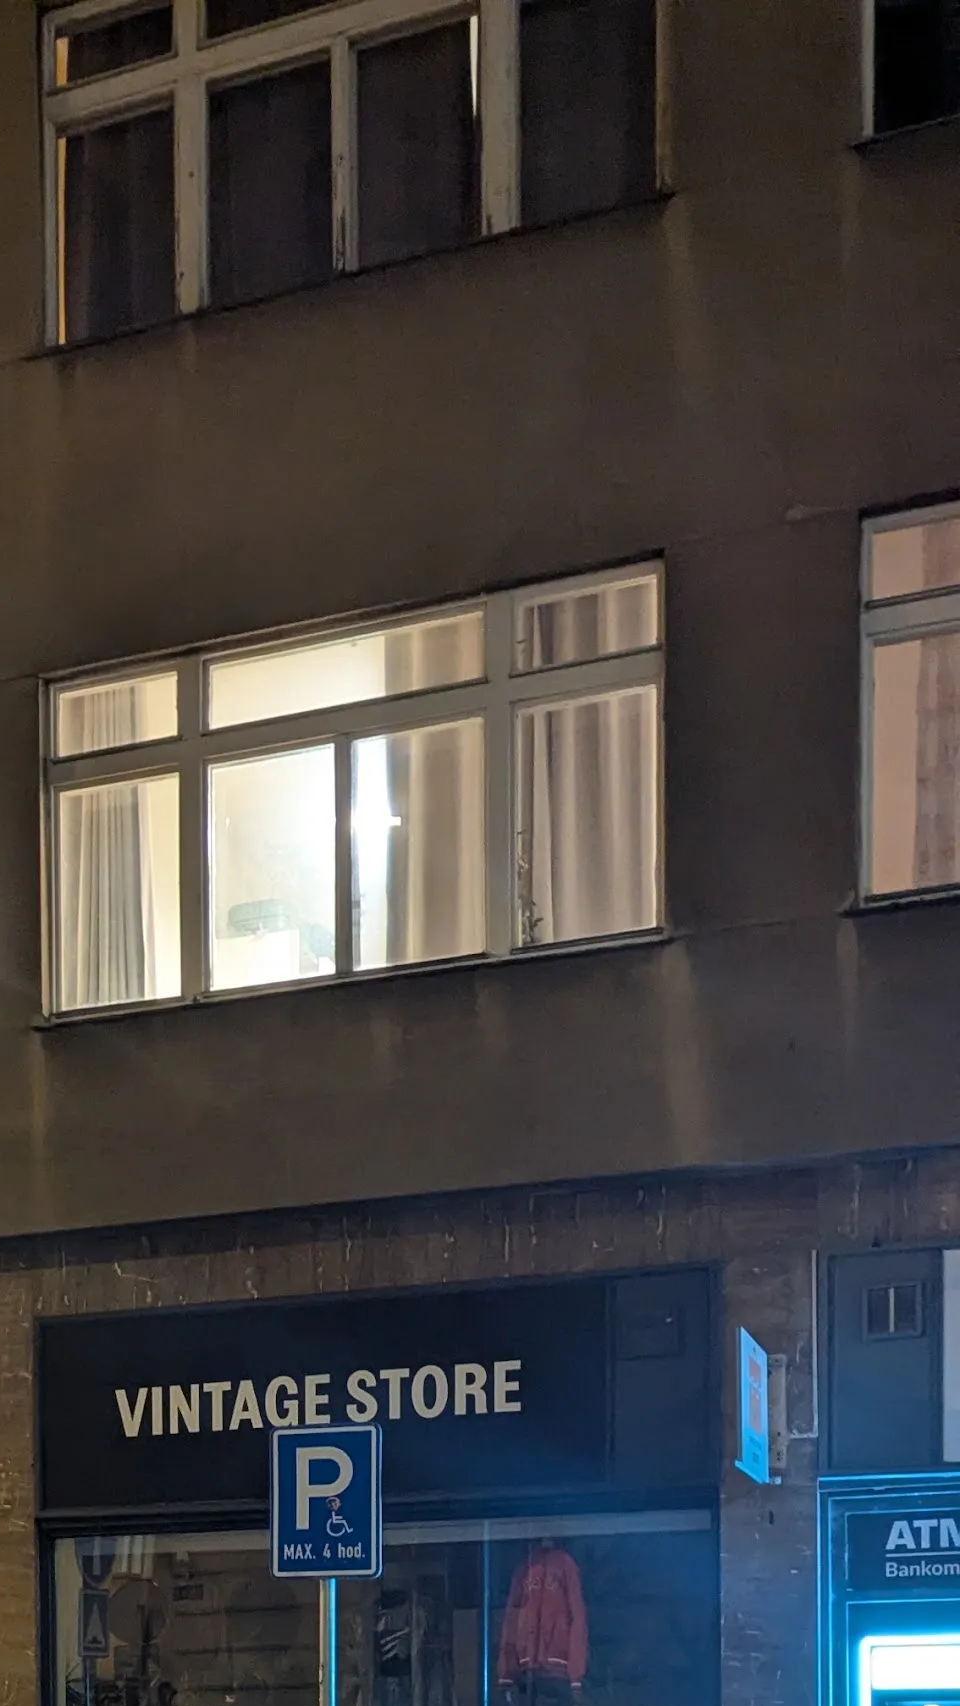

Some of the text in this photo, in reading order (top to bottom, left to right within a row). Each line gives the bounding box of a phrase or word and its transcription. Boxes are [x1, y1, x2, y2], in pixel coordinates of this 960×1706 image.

[114, 1359, 522, 1437] VINTAGE STORE
[296, 1446, 353, 1530] P
[283, 1542, 366, 1560] MAX. 4 hod.
[885, 1518, 960, 1550] ATM
